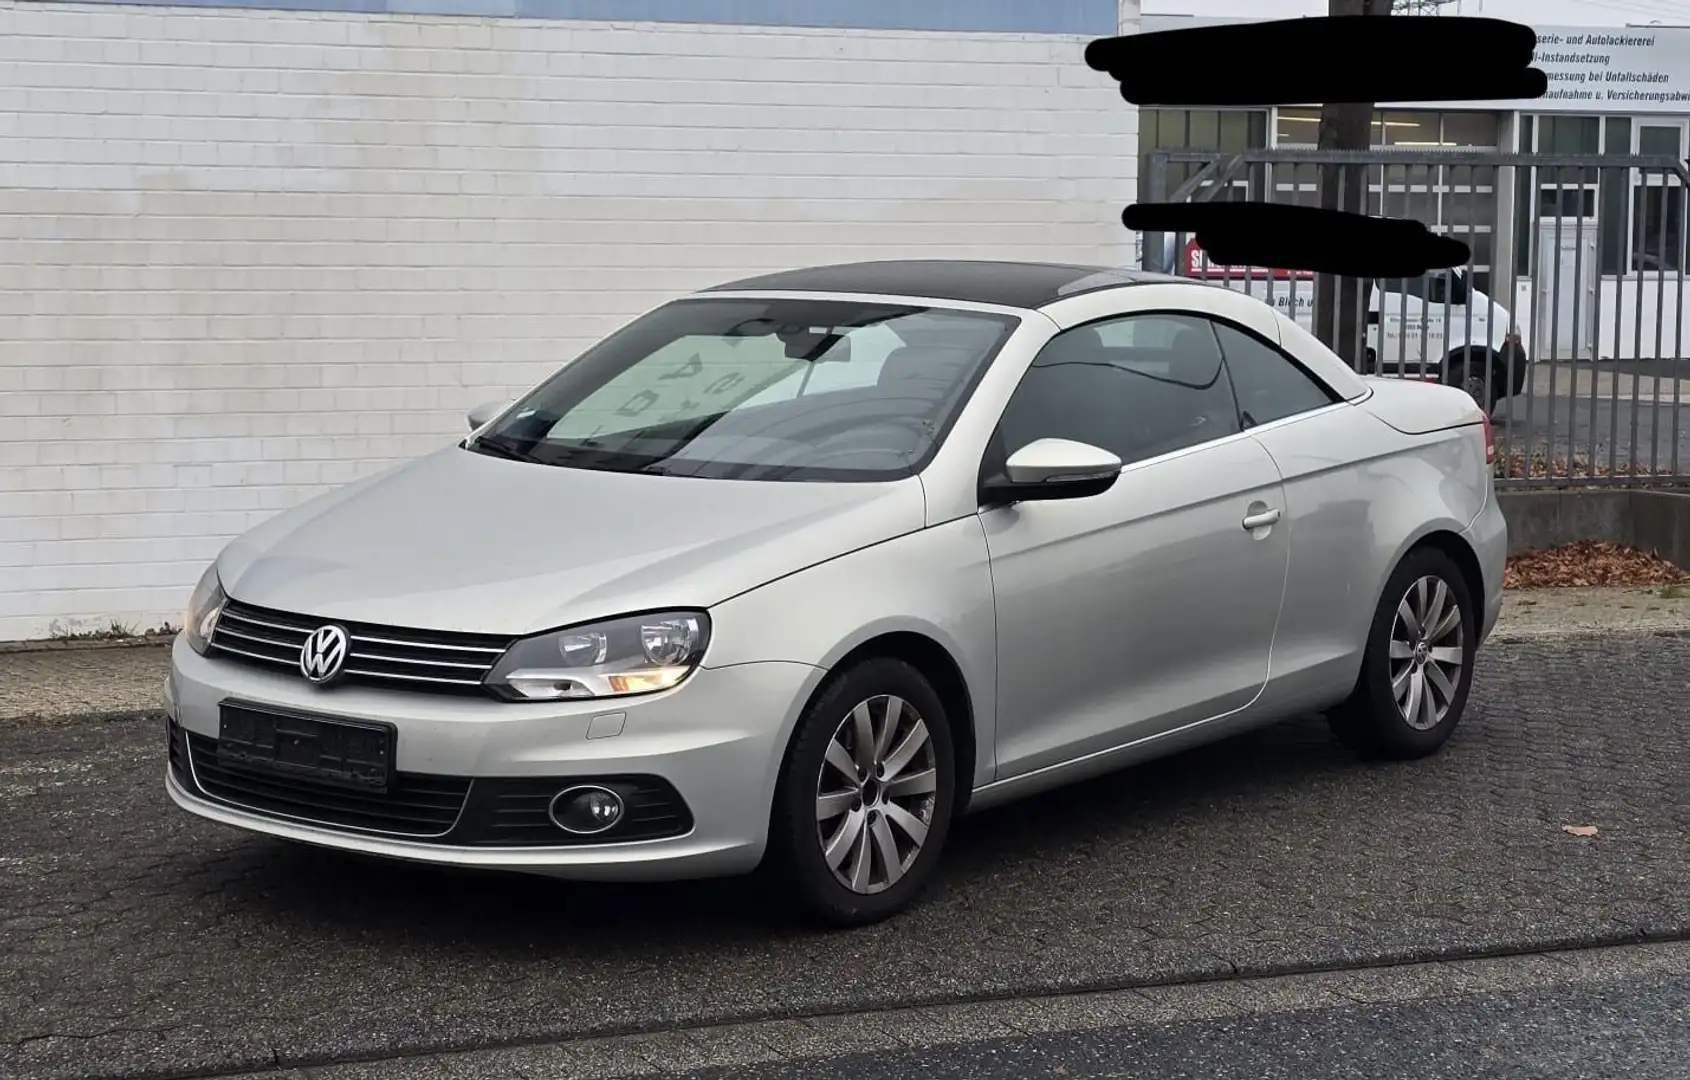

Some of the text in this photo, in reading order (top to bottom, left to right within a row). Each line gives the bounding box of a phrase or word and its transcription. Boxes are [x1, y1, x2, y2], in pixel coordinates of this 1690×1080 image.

[1536, 33, 1656, 46] serie- und Autolackiererei
[1546, 72, 1586, 83] messung
[1588, 71, 1603, 82] bei
[1543, 89, 1593, 100] naufnahme
[1607, 90, 1690, 102] Versicherungsabwi
